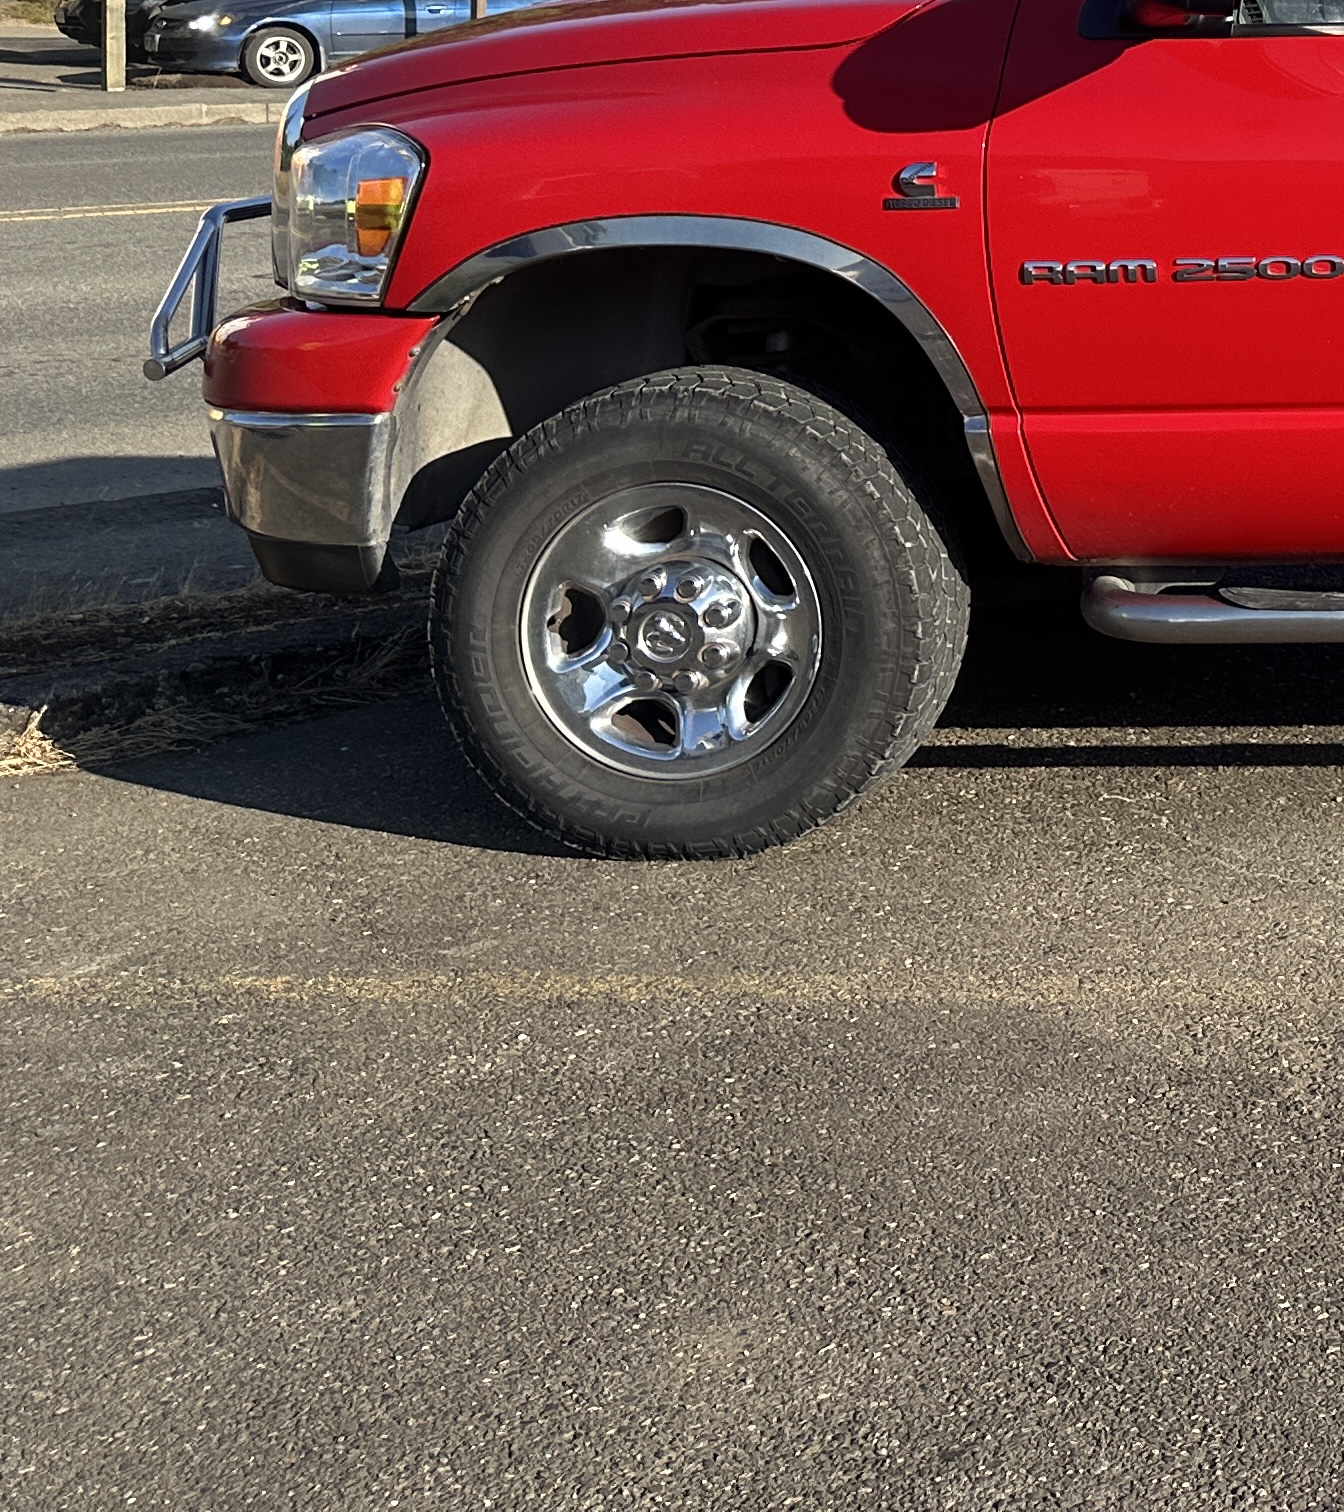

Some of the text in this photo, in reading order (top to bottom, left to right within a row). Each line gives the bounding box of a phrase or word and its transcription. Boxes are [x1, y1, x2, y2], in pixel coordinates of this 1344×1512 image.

[1021, 258, 1159, 285] RAM
[681, 442, 867, 638] ALL TERRAIN
